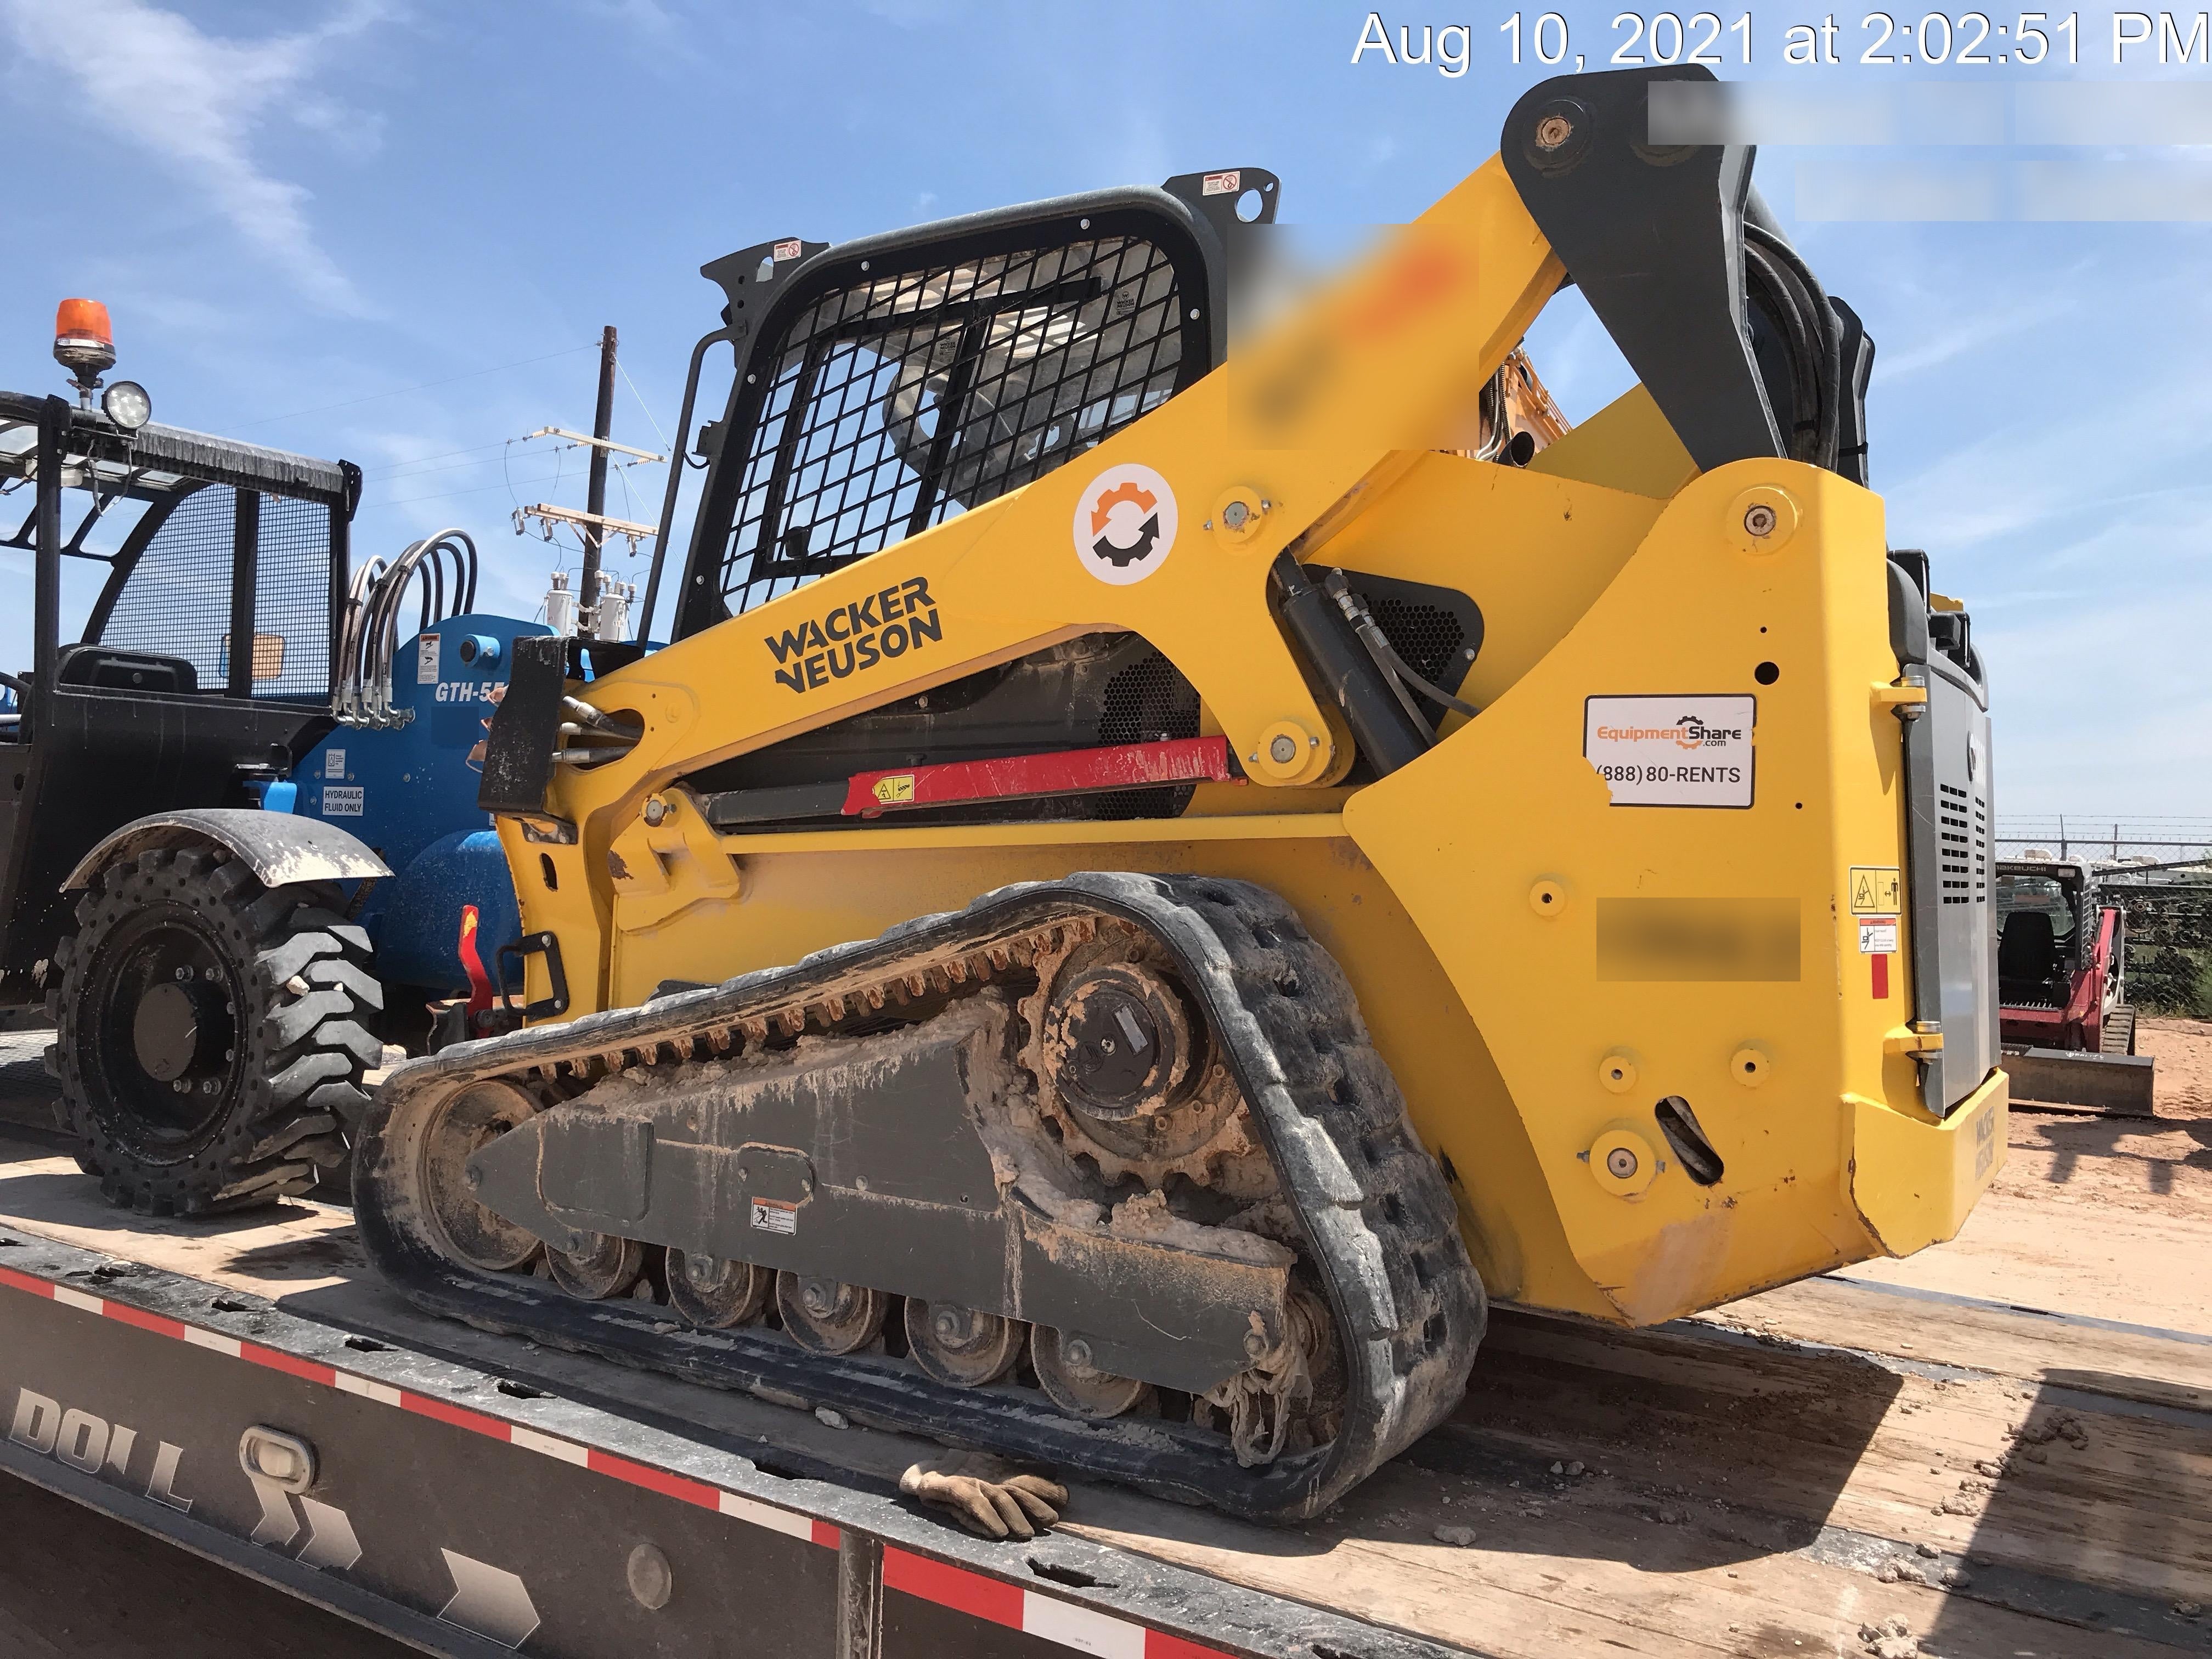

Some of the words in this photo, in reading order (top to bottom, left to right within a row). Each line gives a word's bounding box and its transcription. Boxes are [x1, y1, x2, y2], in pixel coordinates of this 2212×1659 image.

[764, 576, 936, 664] WACKER
[775, 608, 943, 694] NEUSON
[1597, 726, 1742, 742] EquipmentShare
[325, 790, 363, 799] HYDRAULIC
[324, 803, 343, 812] FLUID
[344, 803, 362, 812] ONLY
